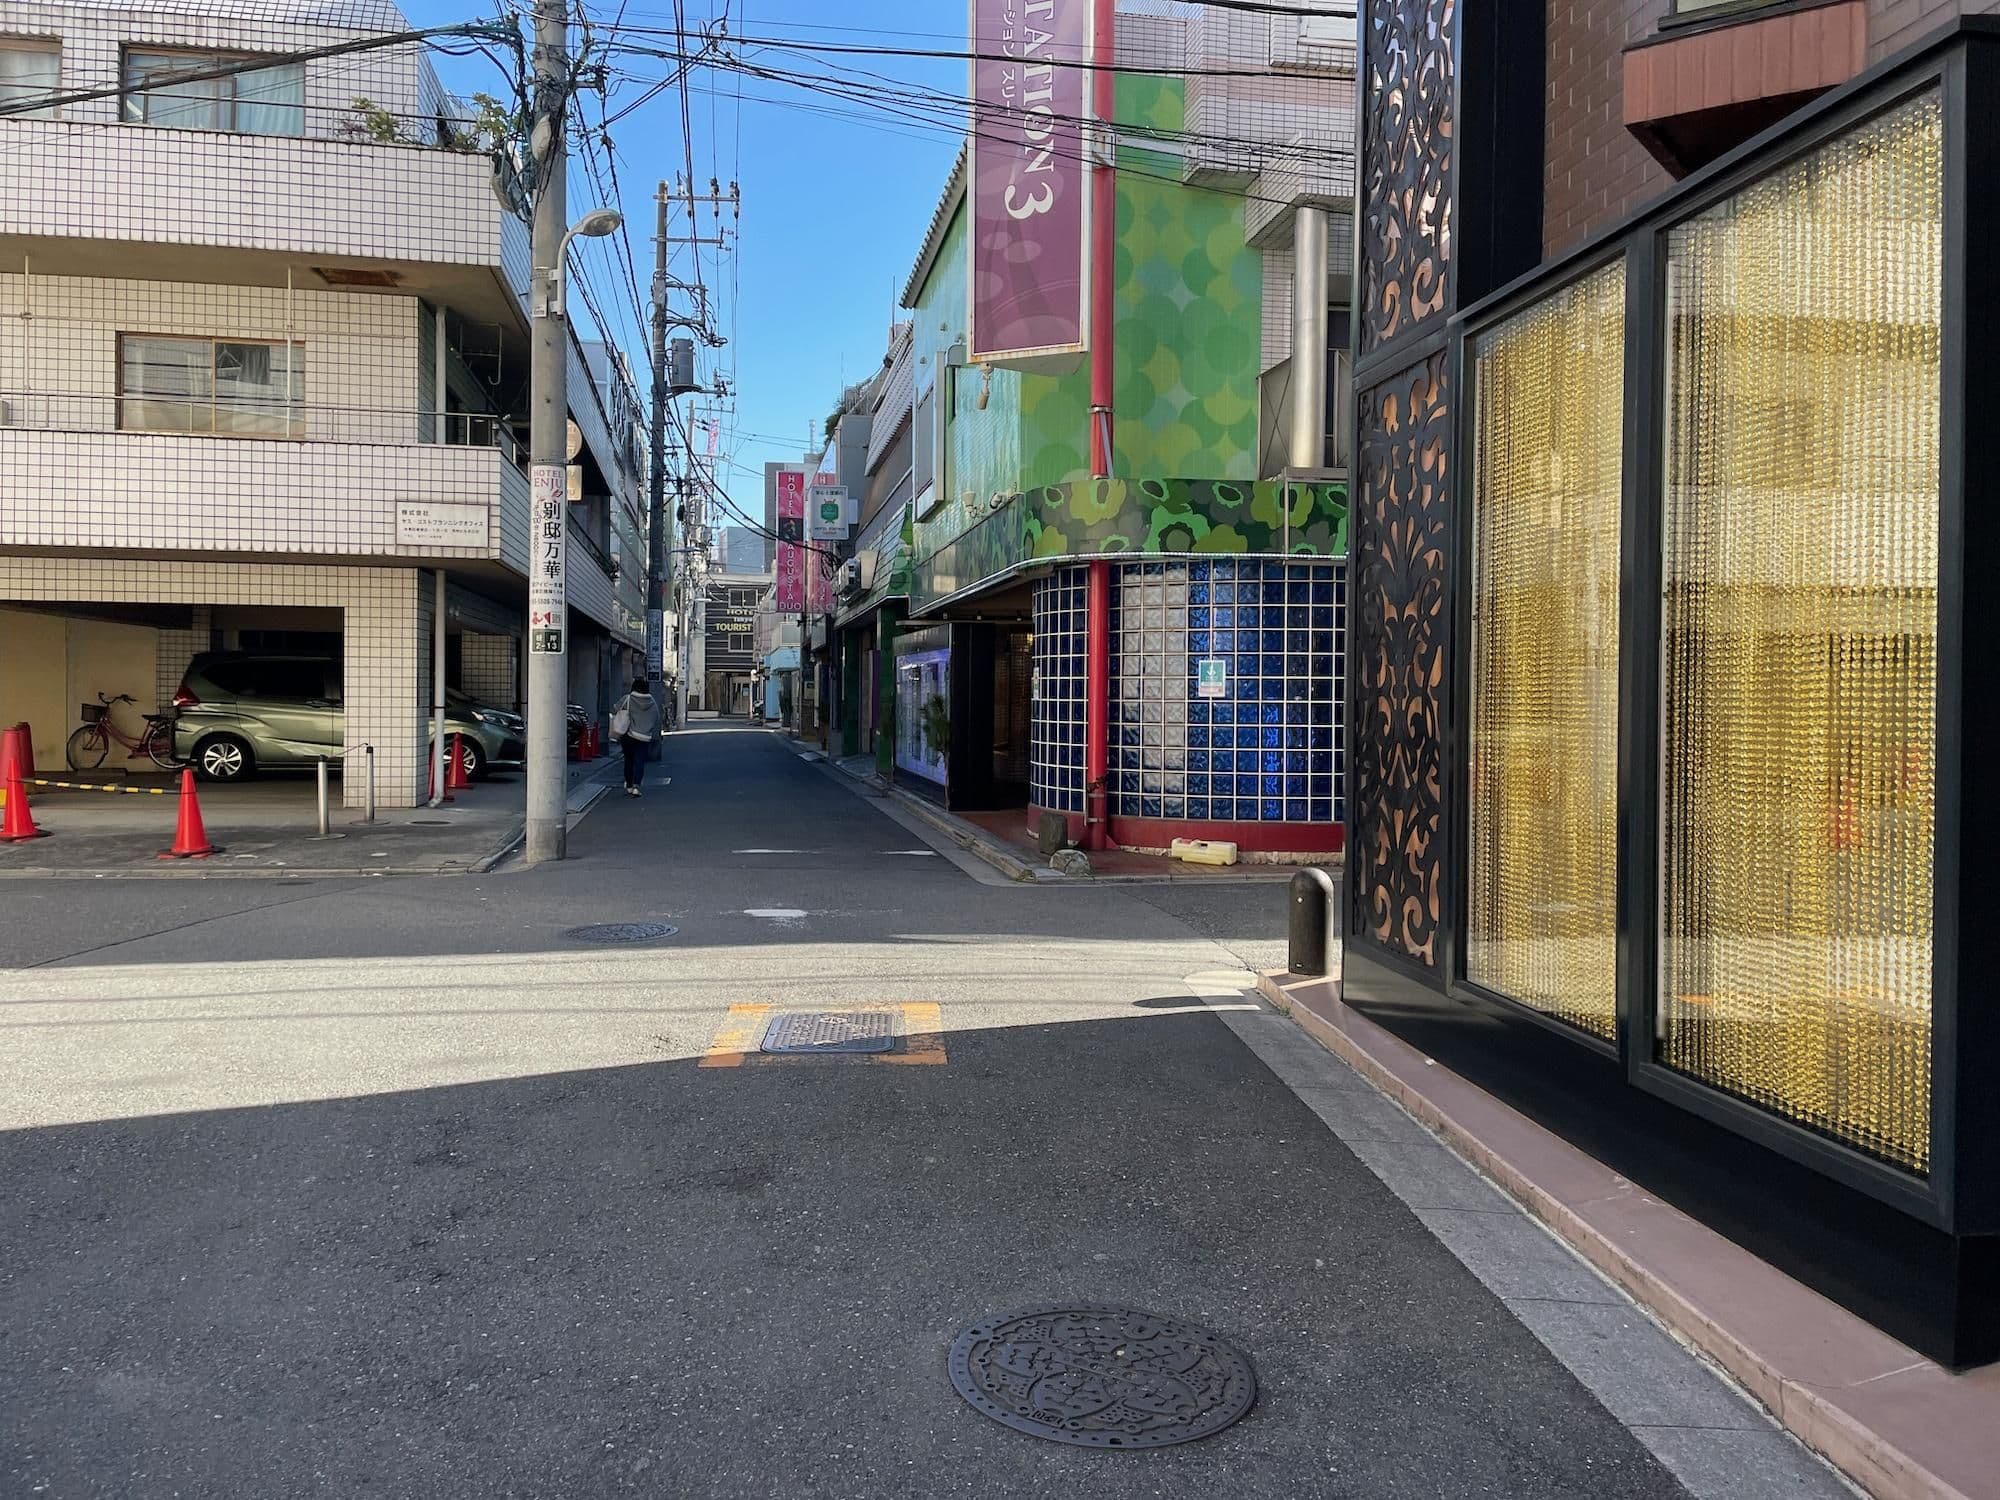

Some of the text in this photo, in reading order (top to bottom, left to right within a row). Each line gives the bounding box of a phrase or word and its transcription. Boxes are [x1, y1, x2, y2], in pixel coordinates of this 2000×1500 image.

[1004, 181, 1054, 220] 3
[533, 470, 563, 478] HOTEL
[534, 477, 564, 490] ENJU
[543, 502, 561, 578] 別邸万華
[787, 475, 796, 600] HOTEL AUGUSTA
[779, 602, 802, 610] DUO
[715, 623, 752, 631] TOURIST
[535, 642, 558, 650] 2-13
